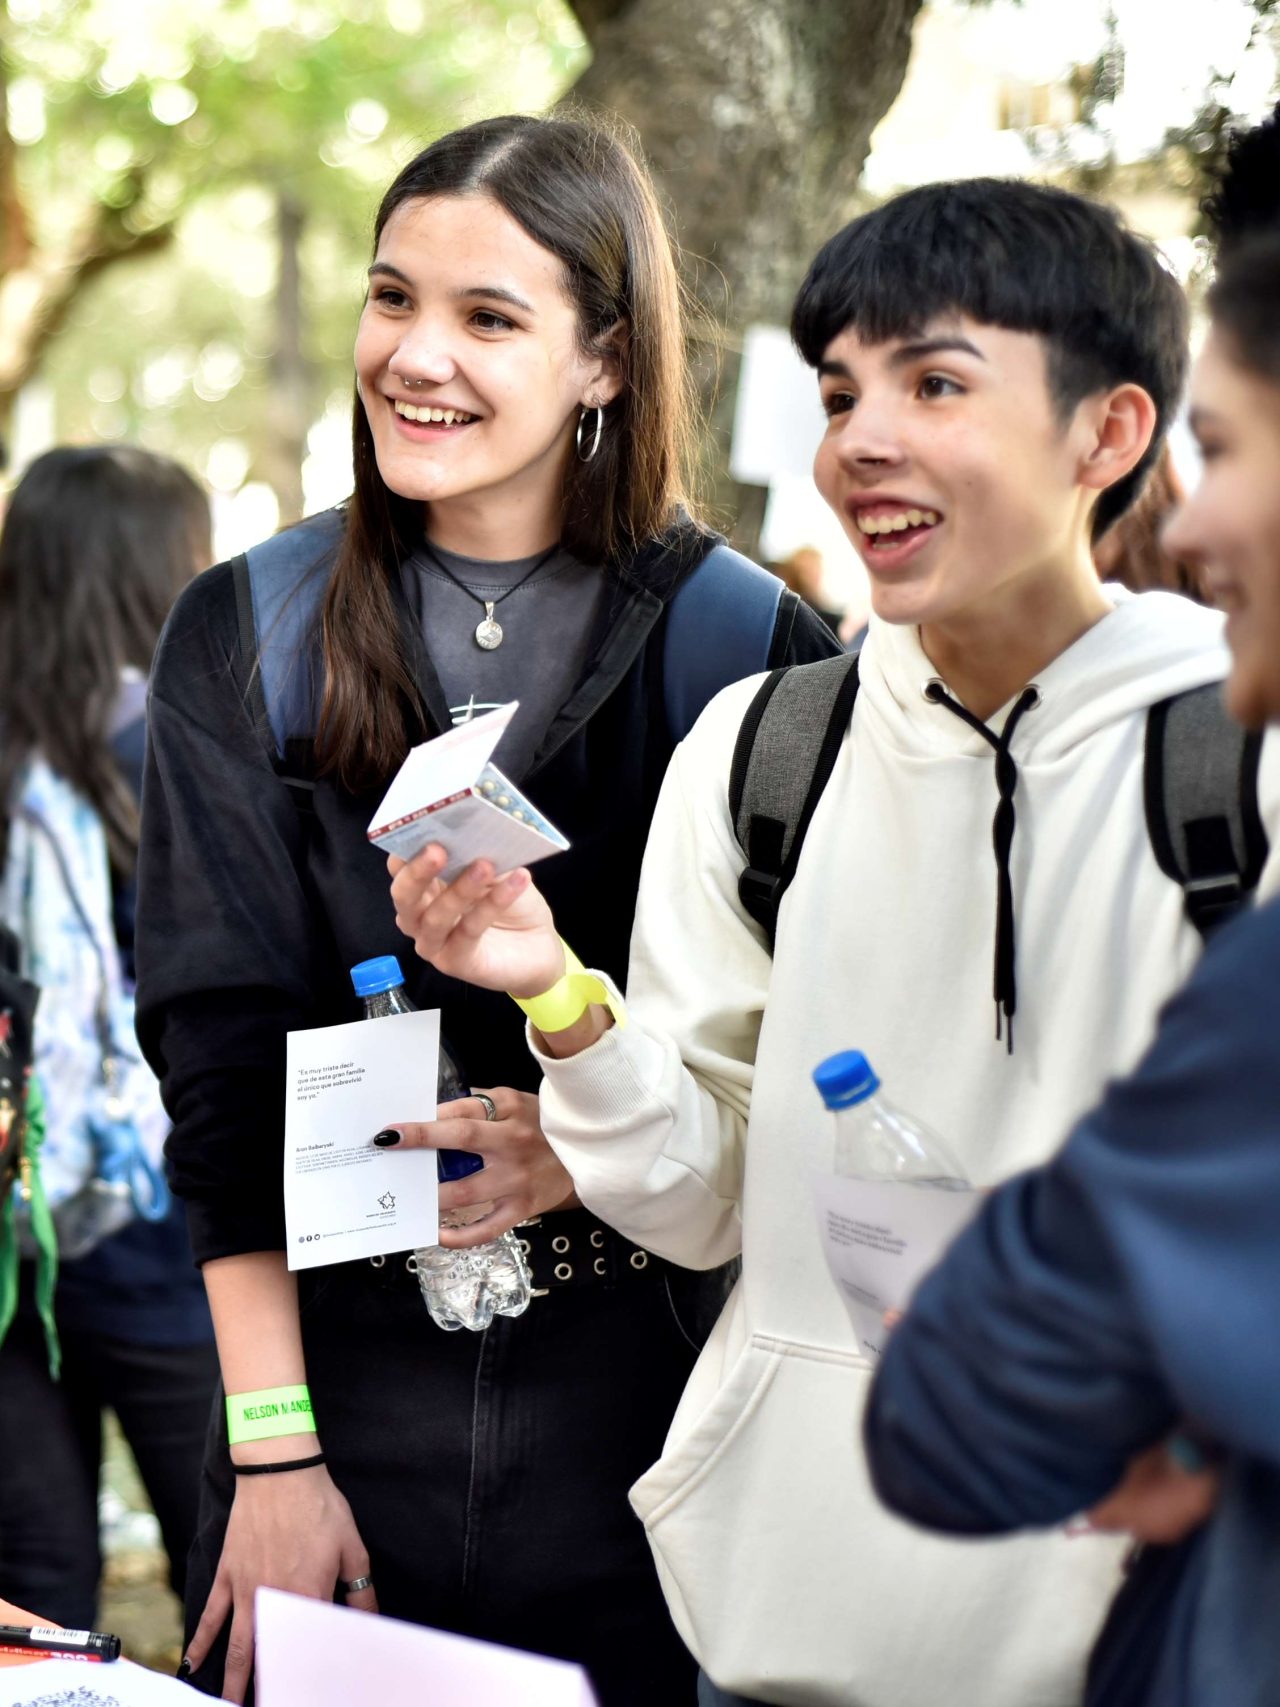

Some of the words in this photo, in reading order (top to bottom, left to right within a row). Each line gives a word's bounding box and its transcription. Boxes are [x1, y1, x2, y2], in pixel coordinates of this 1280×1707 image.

[323, 1064, 338, 1072] triste
[340, 1062, 354, 1070] decir
[346, 1068, 365, 1076] familia
[332, 1077, 362, 1087] sobrevivió
[243, 1404, 279, 1420] NELSON
